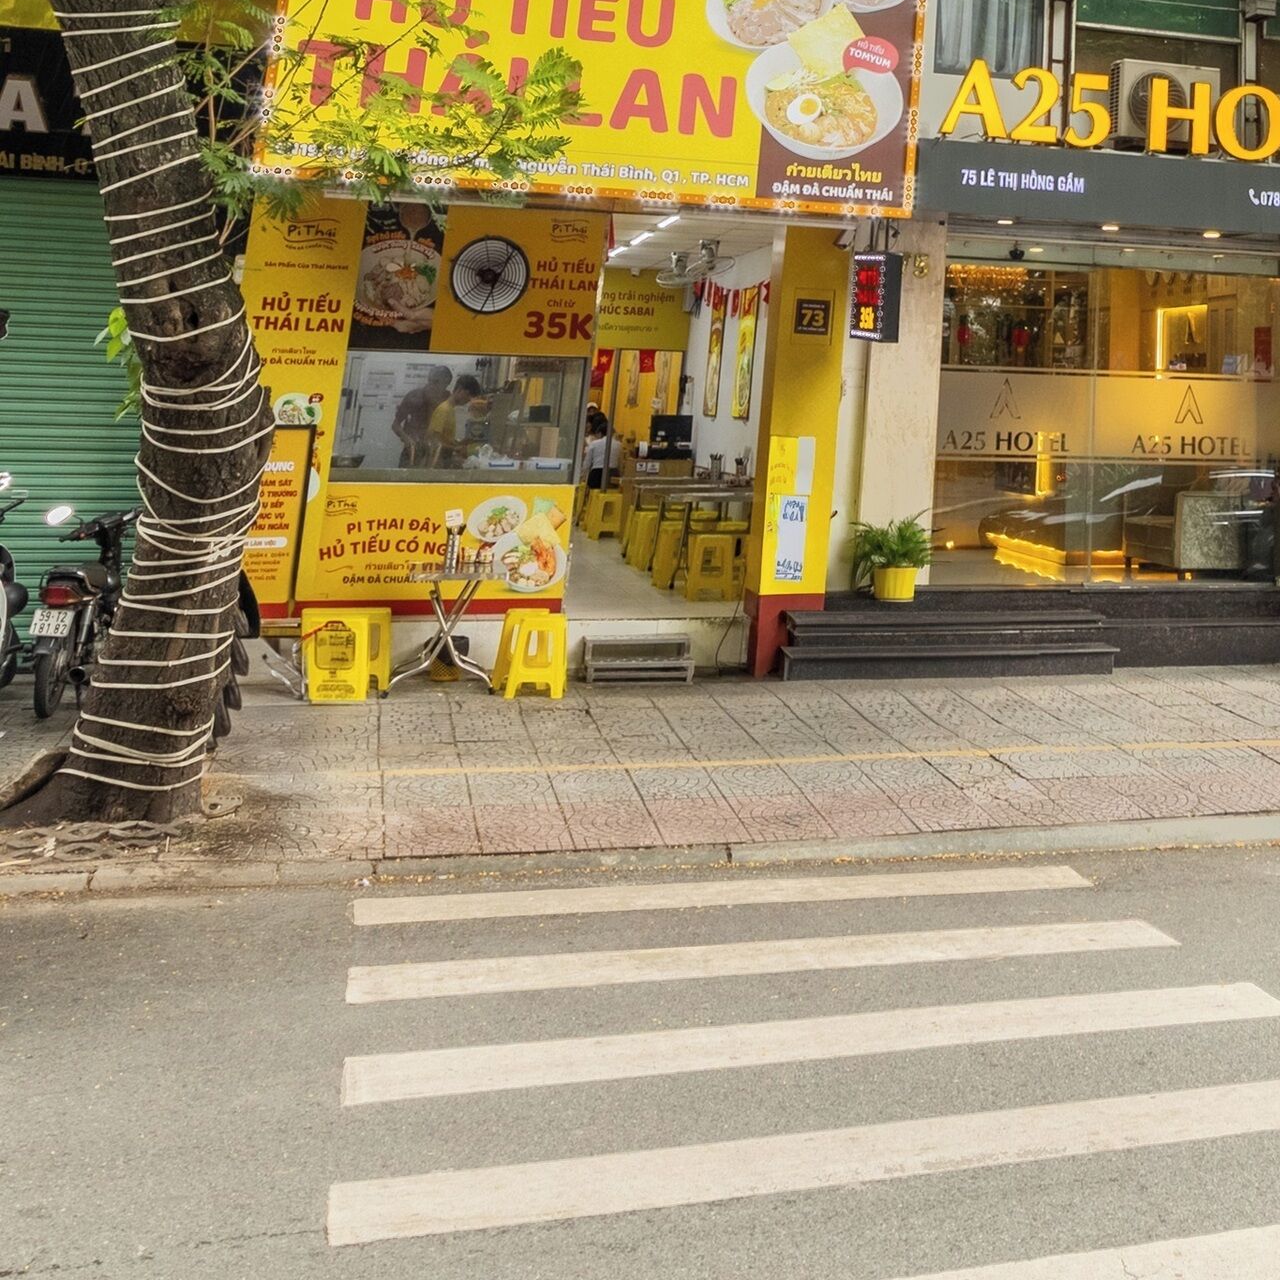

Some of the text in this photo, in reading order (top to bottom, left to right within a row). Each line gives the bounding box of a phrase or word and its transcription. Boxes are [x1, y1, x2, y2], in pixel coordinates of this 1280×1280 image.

[849, 47, 892, 68] TOMYUM
[938, 57, 1112, 150] A25
[581, 163, 615, 178] Thái
[619, 167, 658, 182] Bình,
[715, 174, 750, 188] HCM
[961, 168, 977, 186] 75
[980, 167, 996, 187] LÊ
[998, 171, 1019, 192] THỊ
[1021, 168, 1055, 191] HỒNG
[802, 182, 821, 197] ĐÀ
[821, 183, 864, 200] CHUẨN
[865, 188, 894, 202] THÁI
[536, 256, 595, 274] HỦ TIẾU
[530, 276, 598, 292] THÁI LAN
[261, 292, 291, 312] HỦ
[296, 293, 341, 314] TIẾU
[599, 303, 655, 316] HÚC SABAI
[253, 313, 345, 333] THÁI LAN
[523, 310, 594, 340] 35K
[801, 309, 825, 327] 73
[942, 428, 986, 451] A25
[1131, 434, 1252, 456] A25 HOTEL
[346, 517, 441, 535] PI THAI ĐÂY
[319, 539, 345, 561] HỦ
[350, 533, 390, 556] TIẾU
[395, 536, 420, 553] CÓ
[367, 574, 381, 584] ĐÀ
